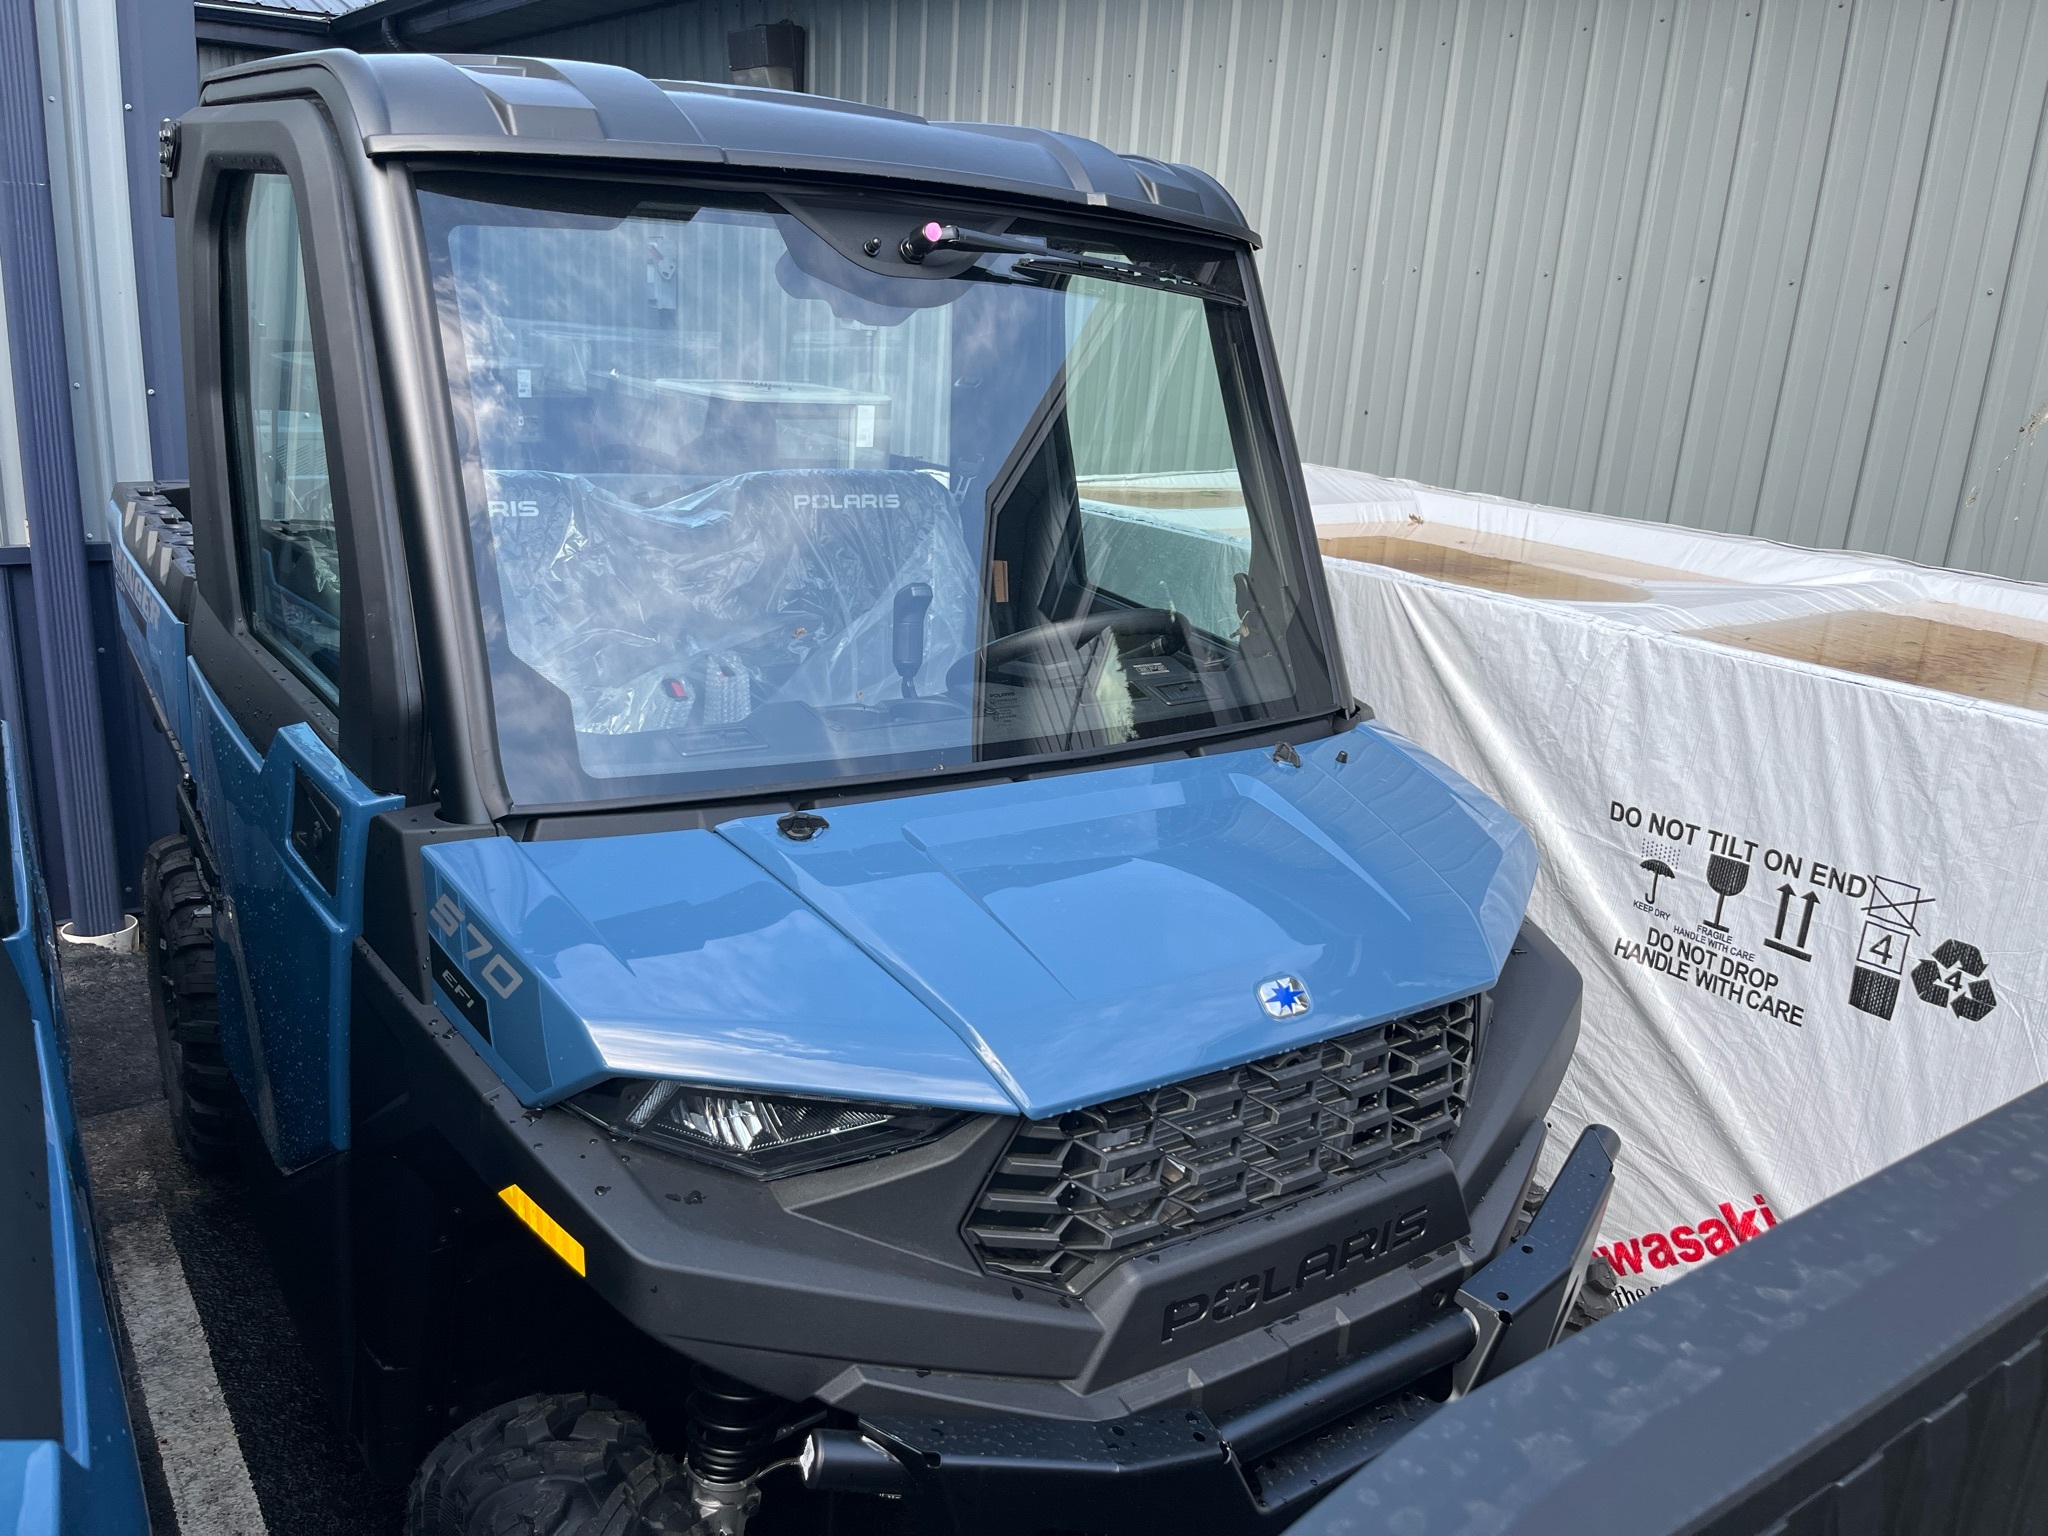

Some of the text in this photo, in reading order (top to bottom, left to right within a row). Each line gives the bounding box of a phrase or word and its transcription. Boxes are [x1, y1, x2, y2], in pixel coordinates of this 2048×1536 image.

[793, 493, 900, 509] POLARIS
[115, 543, 162, 632] RANGER
[1610, 800, 1867, 898] DO NOT TILT ON END
[1632, 899, 1671, 921] KEEP DRY
[430, 893, 523, 999] 570
[1673, 925, 1756, 963] HANDLE WITH CARE
[1696, 924, 1733, 944] FRAGILE
[1869, 934, 1893, 965] 4
[1646, 927, 1779, 992] DO NOT DROP
[442, 969, 475, 1008] EFI
[1613, 937, 1804, 1027] HANDLE WITH CARE
[1944, 970, 1963, 992] 4
[1592, 1193, 1777, 1277] wasaki
[1161, 1203, 1428, 1344] POLARIS
[1615, 1285, 1646, 1309] the
